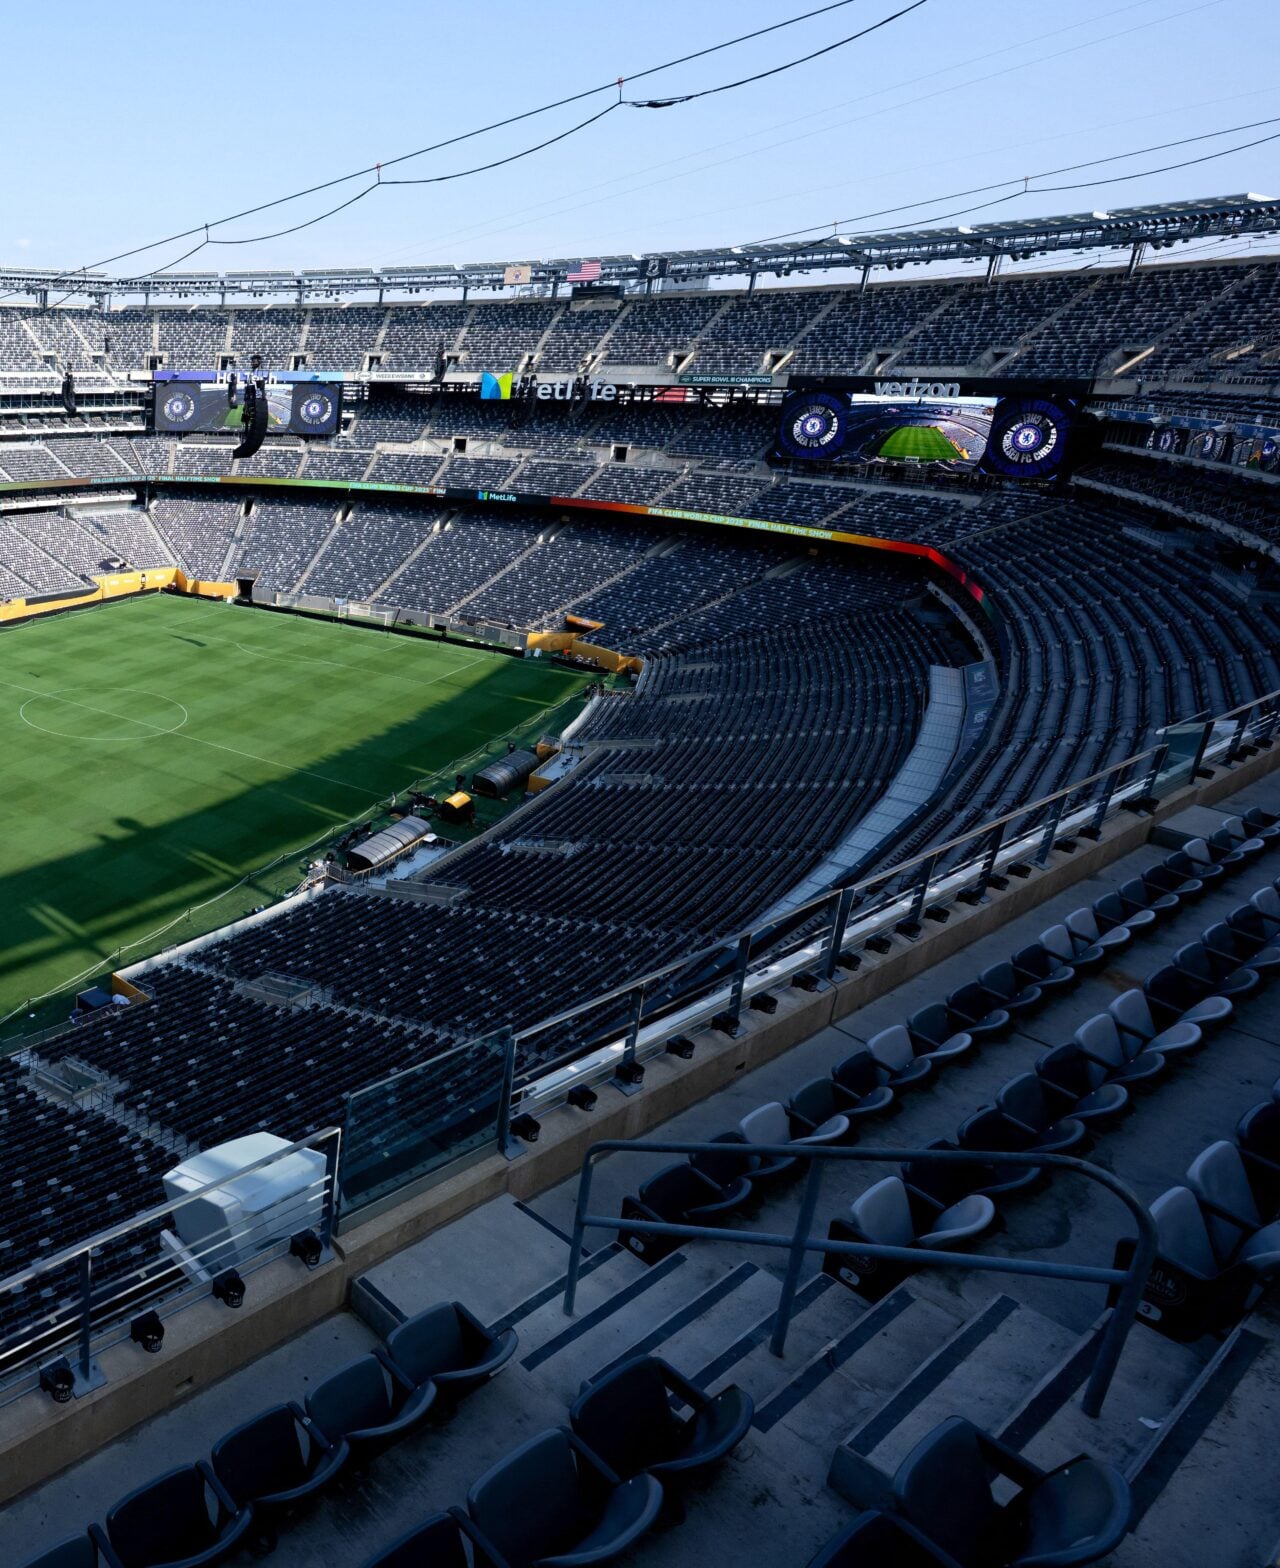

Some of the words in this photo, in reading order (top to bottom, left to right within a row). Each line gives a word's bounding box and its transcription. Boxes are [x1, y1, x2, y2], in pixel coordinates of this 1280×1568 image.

[874, 378, 960, 398] verizon
[488, 492, 517, 502] MetLife
[648, 507, 663, 515] FIFA
[664, 509, 683, 517] CLUB
[683, 511, 709, 521] WORLD
[710, 514, 725, 522] CUP
[748, 519, 768, 530] FINAL
[770, 523, 807, 535] HALFTIME
[809, 530, 833, 540] SHOW
[845, 1271, 853, 1281] 2
[1141, 1304, 1153, 1314] 3
